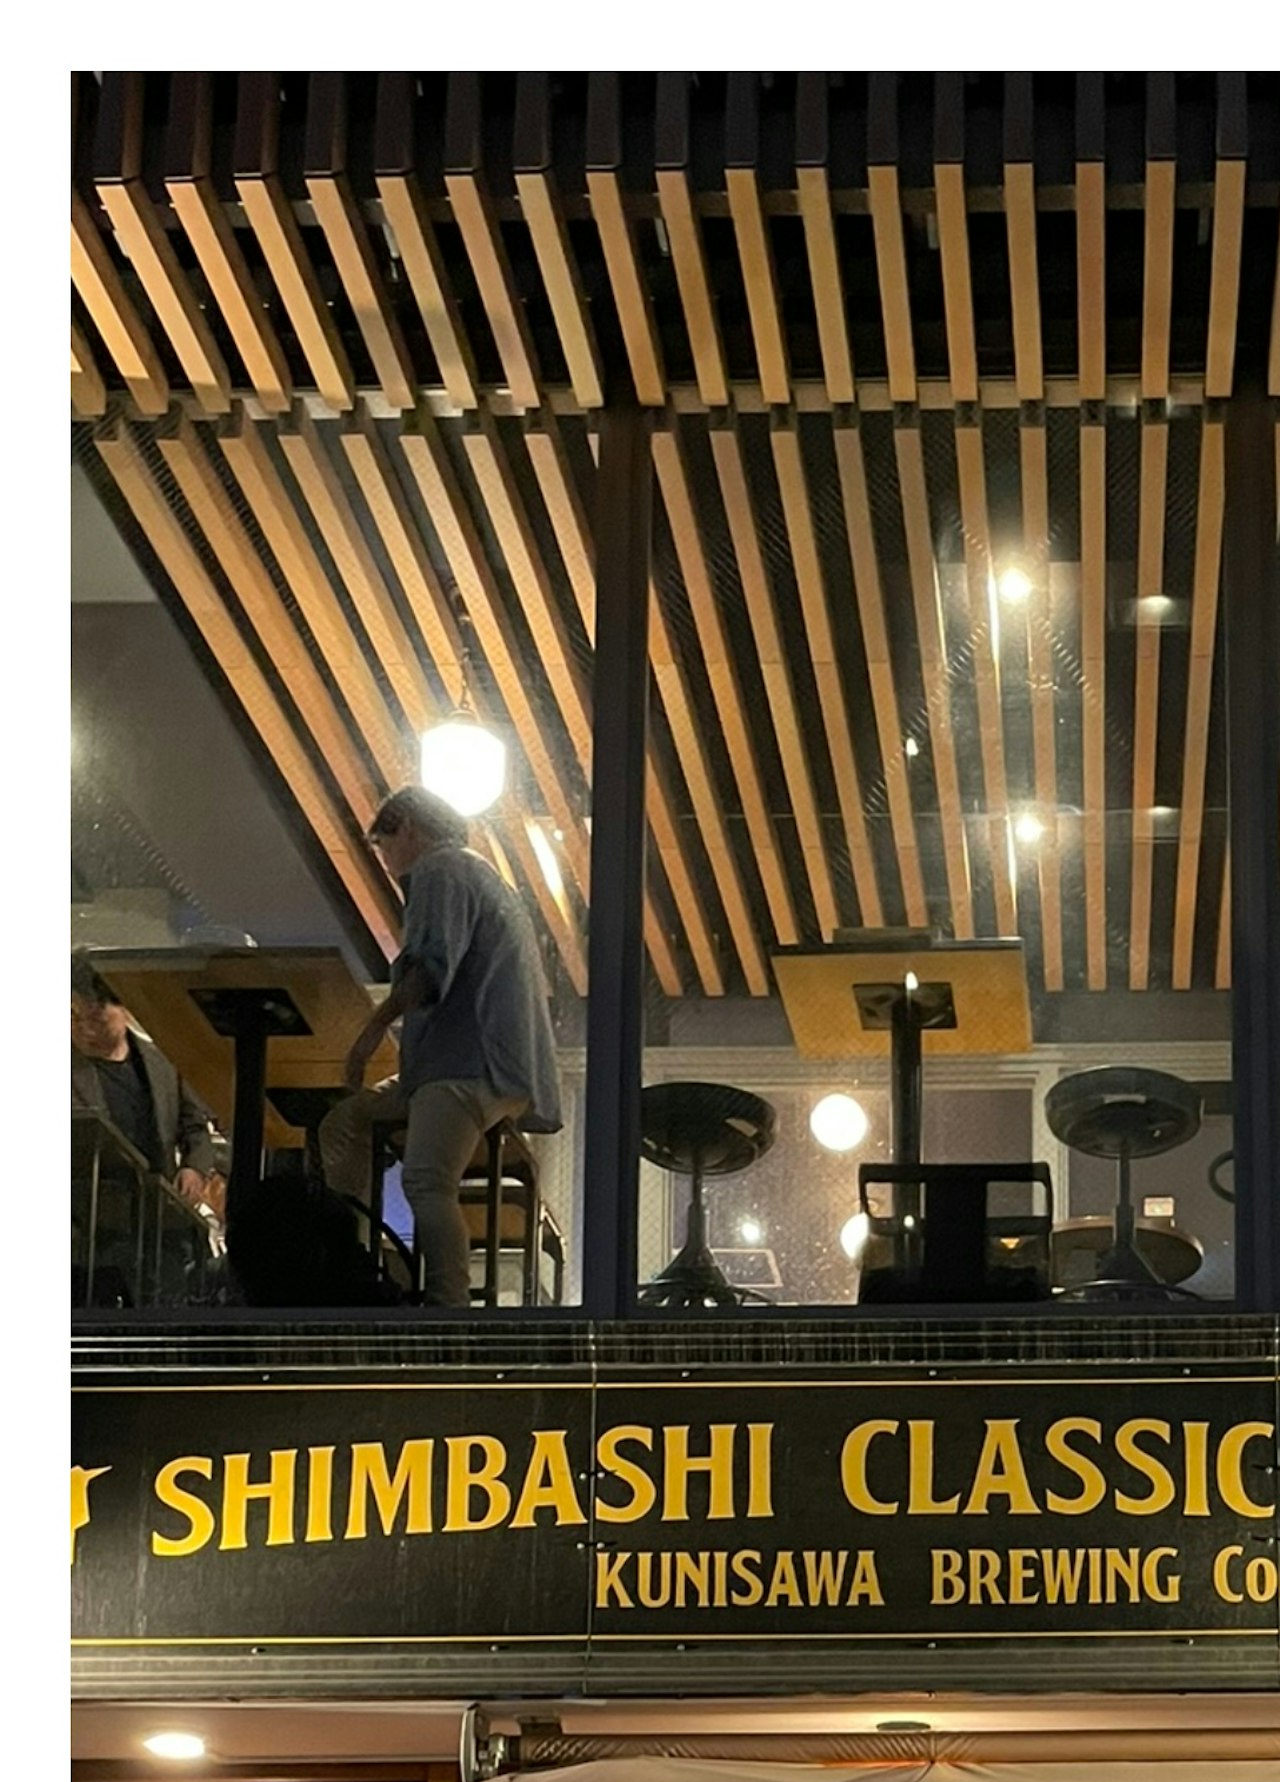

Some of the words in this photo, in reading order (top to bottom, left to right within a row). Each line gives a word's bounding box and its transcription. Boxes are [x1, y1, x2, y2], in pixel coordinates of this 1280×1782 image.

[152, 1421, 775, 1557] SHIMBASHI
[840, 1417, 1276, 1519] CLASSIC
[596, 1549, 885, 1608] KUNISAWA
[930, 1546, 1181, 1606] BREWING
